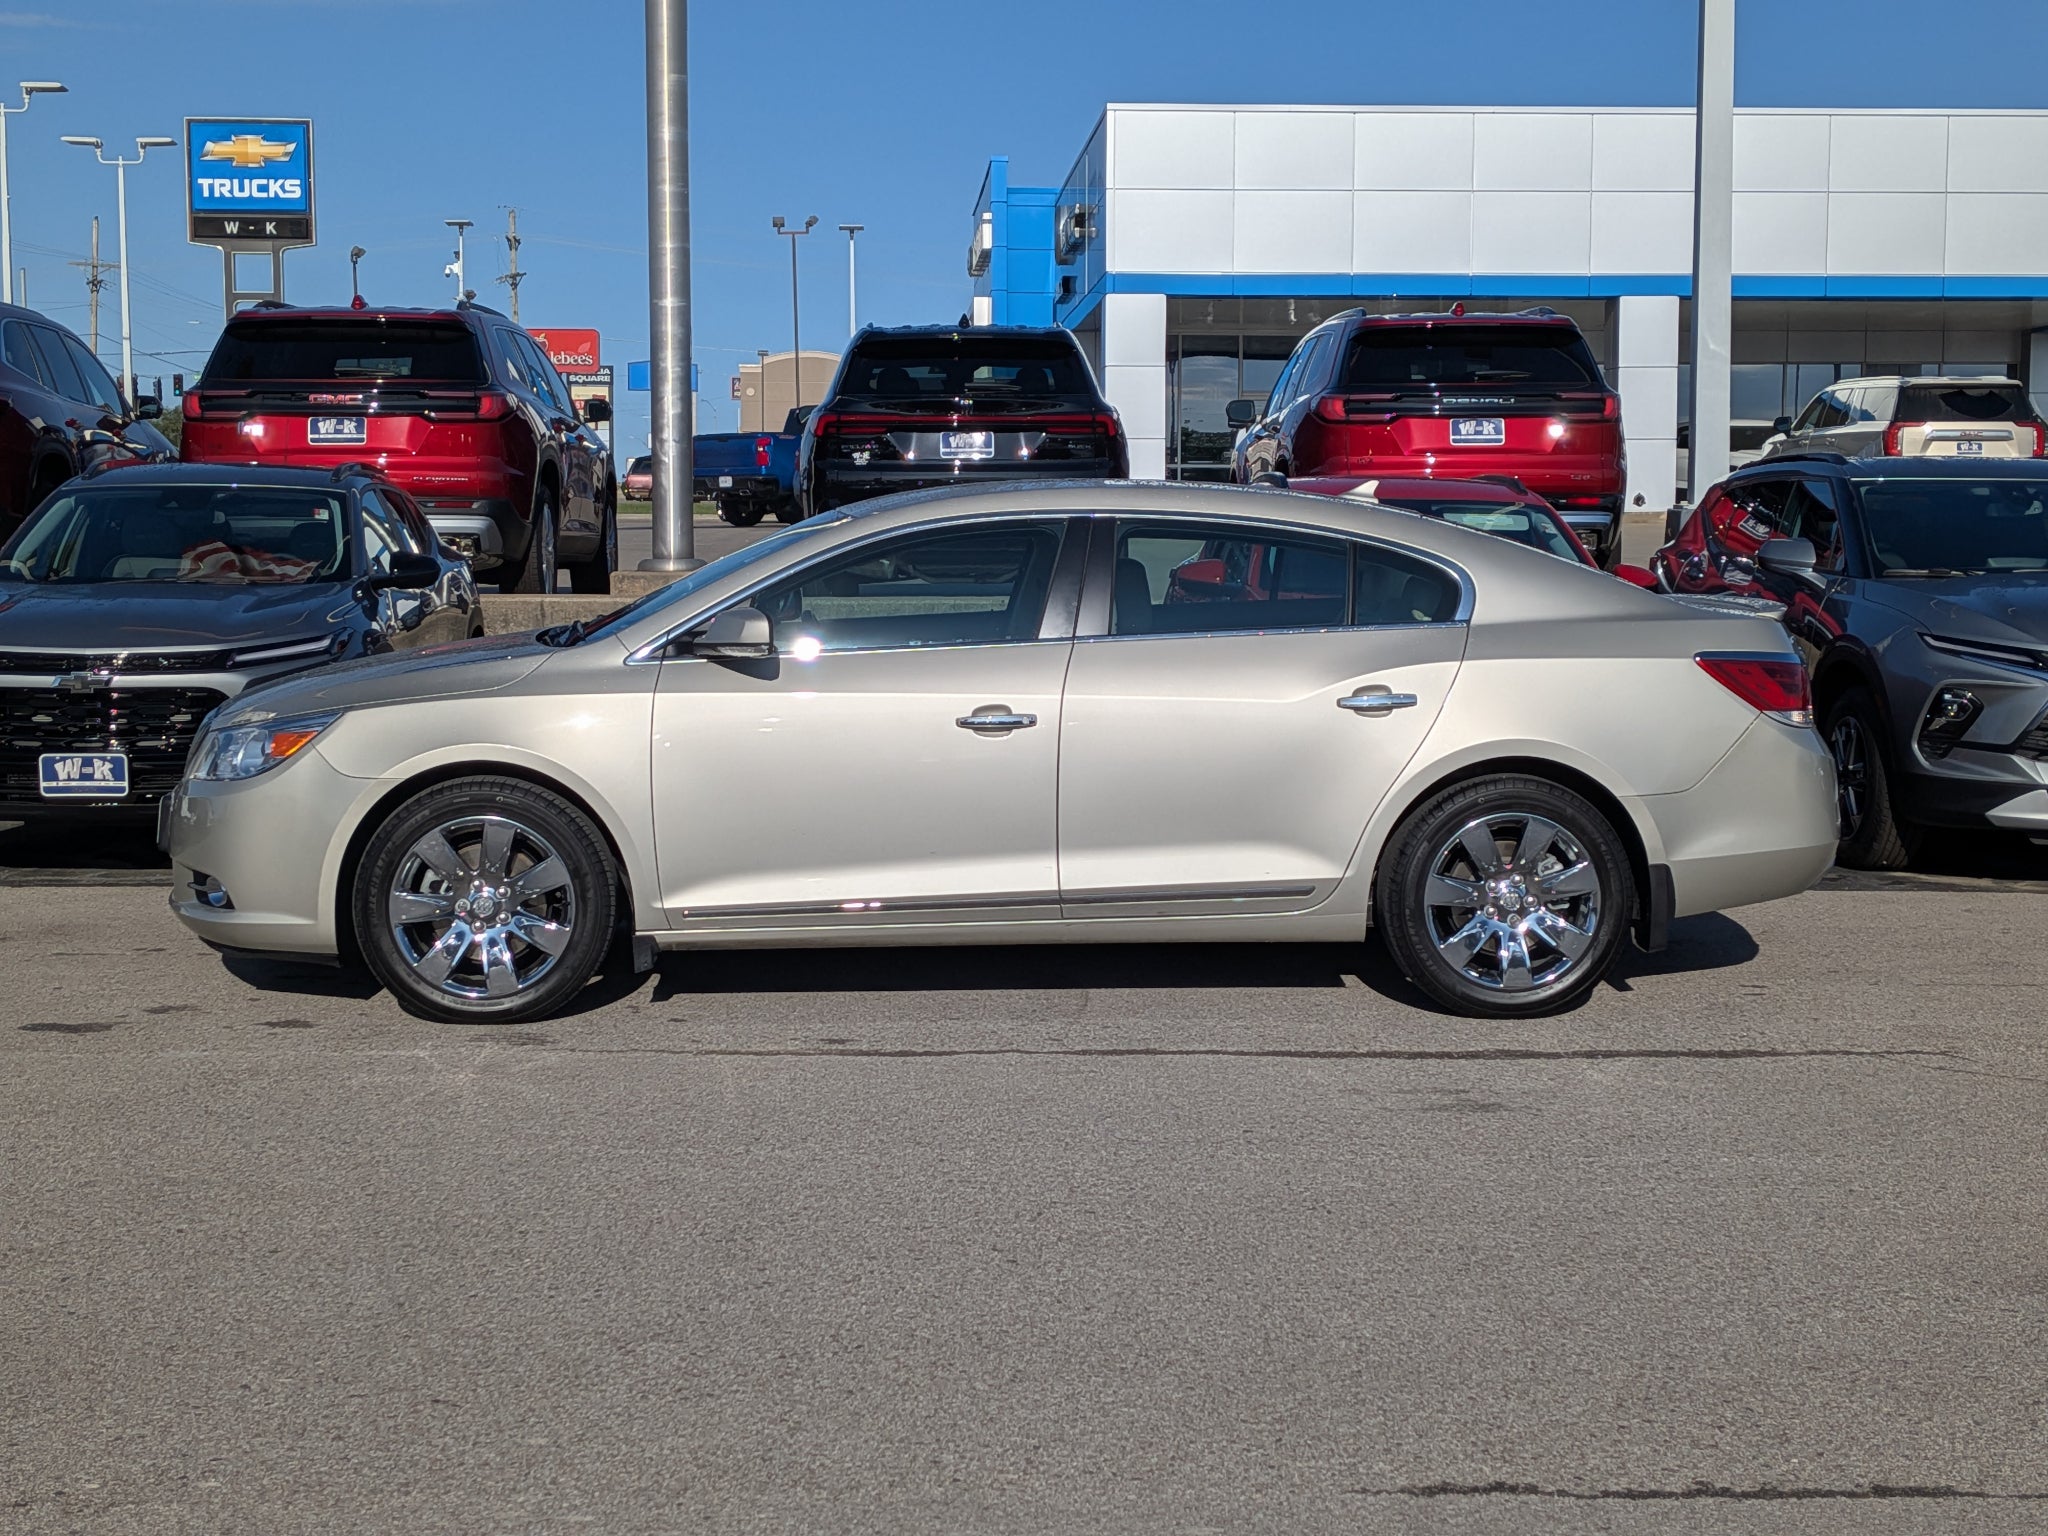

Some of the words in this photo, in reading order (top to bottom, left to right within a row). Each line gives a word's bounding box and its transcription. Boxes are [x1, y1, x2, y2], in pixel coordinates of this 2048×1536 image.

[197, 178, 302, 198] TRUCKS
[550, 350, 593, 365] lebee's
[568, 374, 611, 384] SQUARE
[308, 393, 363, 405] GMC
[317, 418, 358, 434] W-K
[1458, 420, 1497, 435] W-K
[54, 757, 115, 781] W-K
